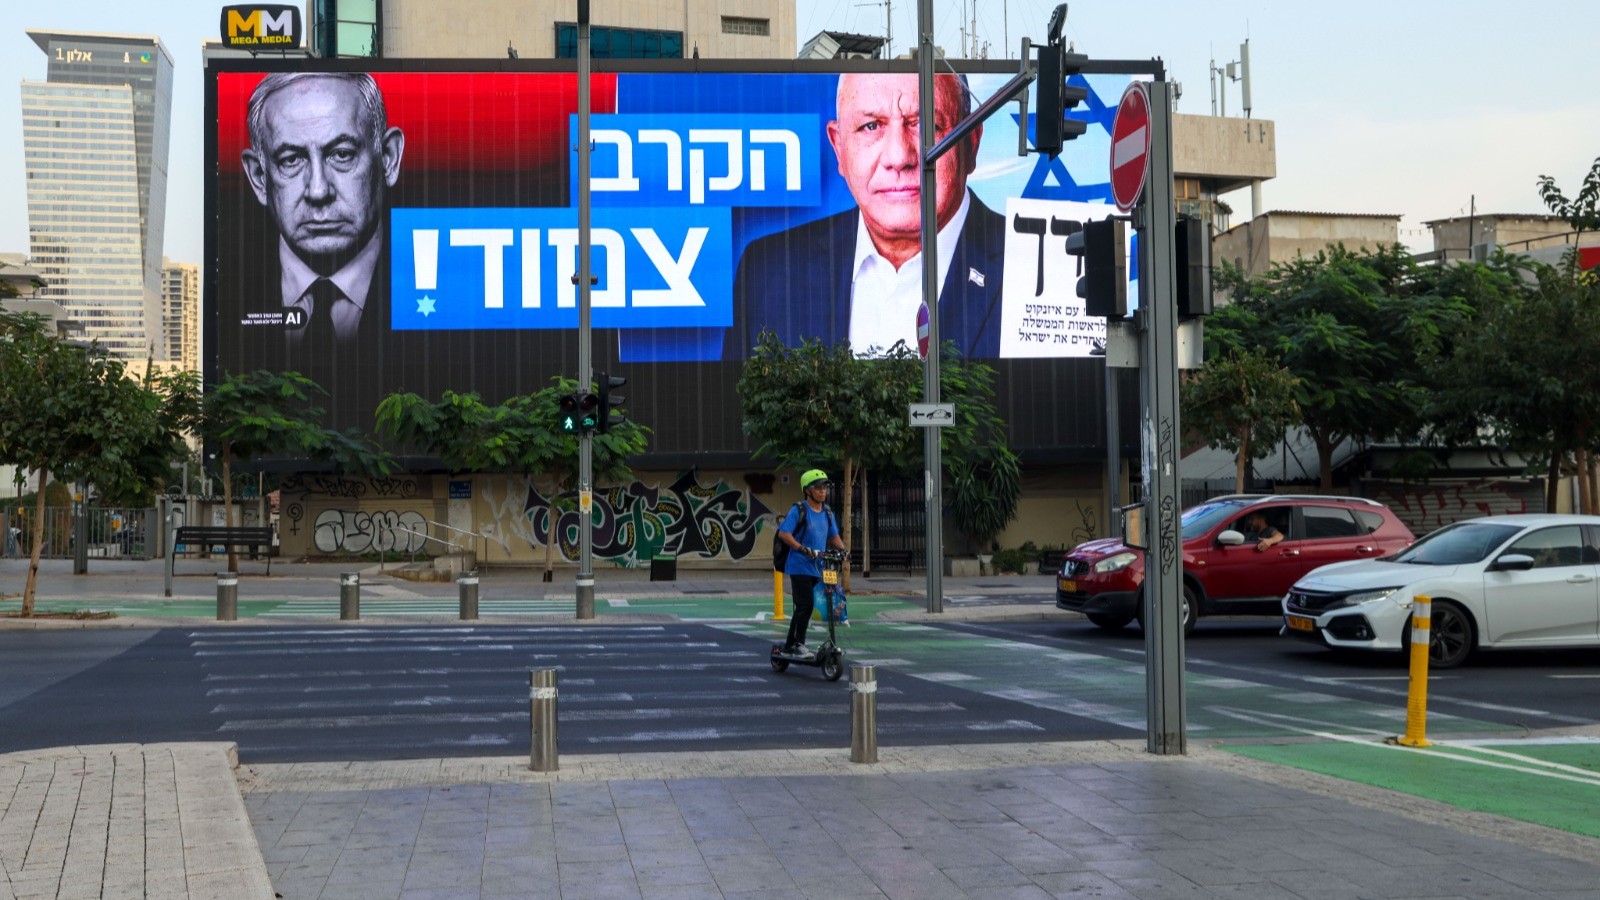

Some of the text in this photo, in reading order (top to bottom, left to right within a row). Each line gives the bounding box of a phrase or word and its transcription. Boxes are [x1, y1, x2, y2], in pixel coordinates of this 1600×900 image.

[228, 9, 292, 37] MM
[230, 35, 292, 45] MEGA MEDIA
[55, 47, 92, 63] אלון 1
[589, 129, 801, 204] הקרב
[412, 227, 709, 317] צמוד!
[1025, 304, 1062, 316] איזנקוט
[285, 312, 301, 325] AI
[1022, 315, 1064, 329] הממשלה
[1018, 328, 1051, 343] ישראל
[1053, 334, 1068, 344] את
